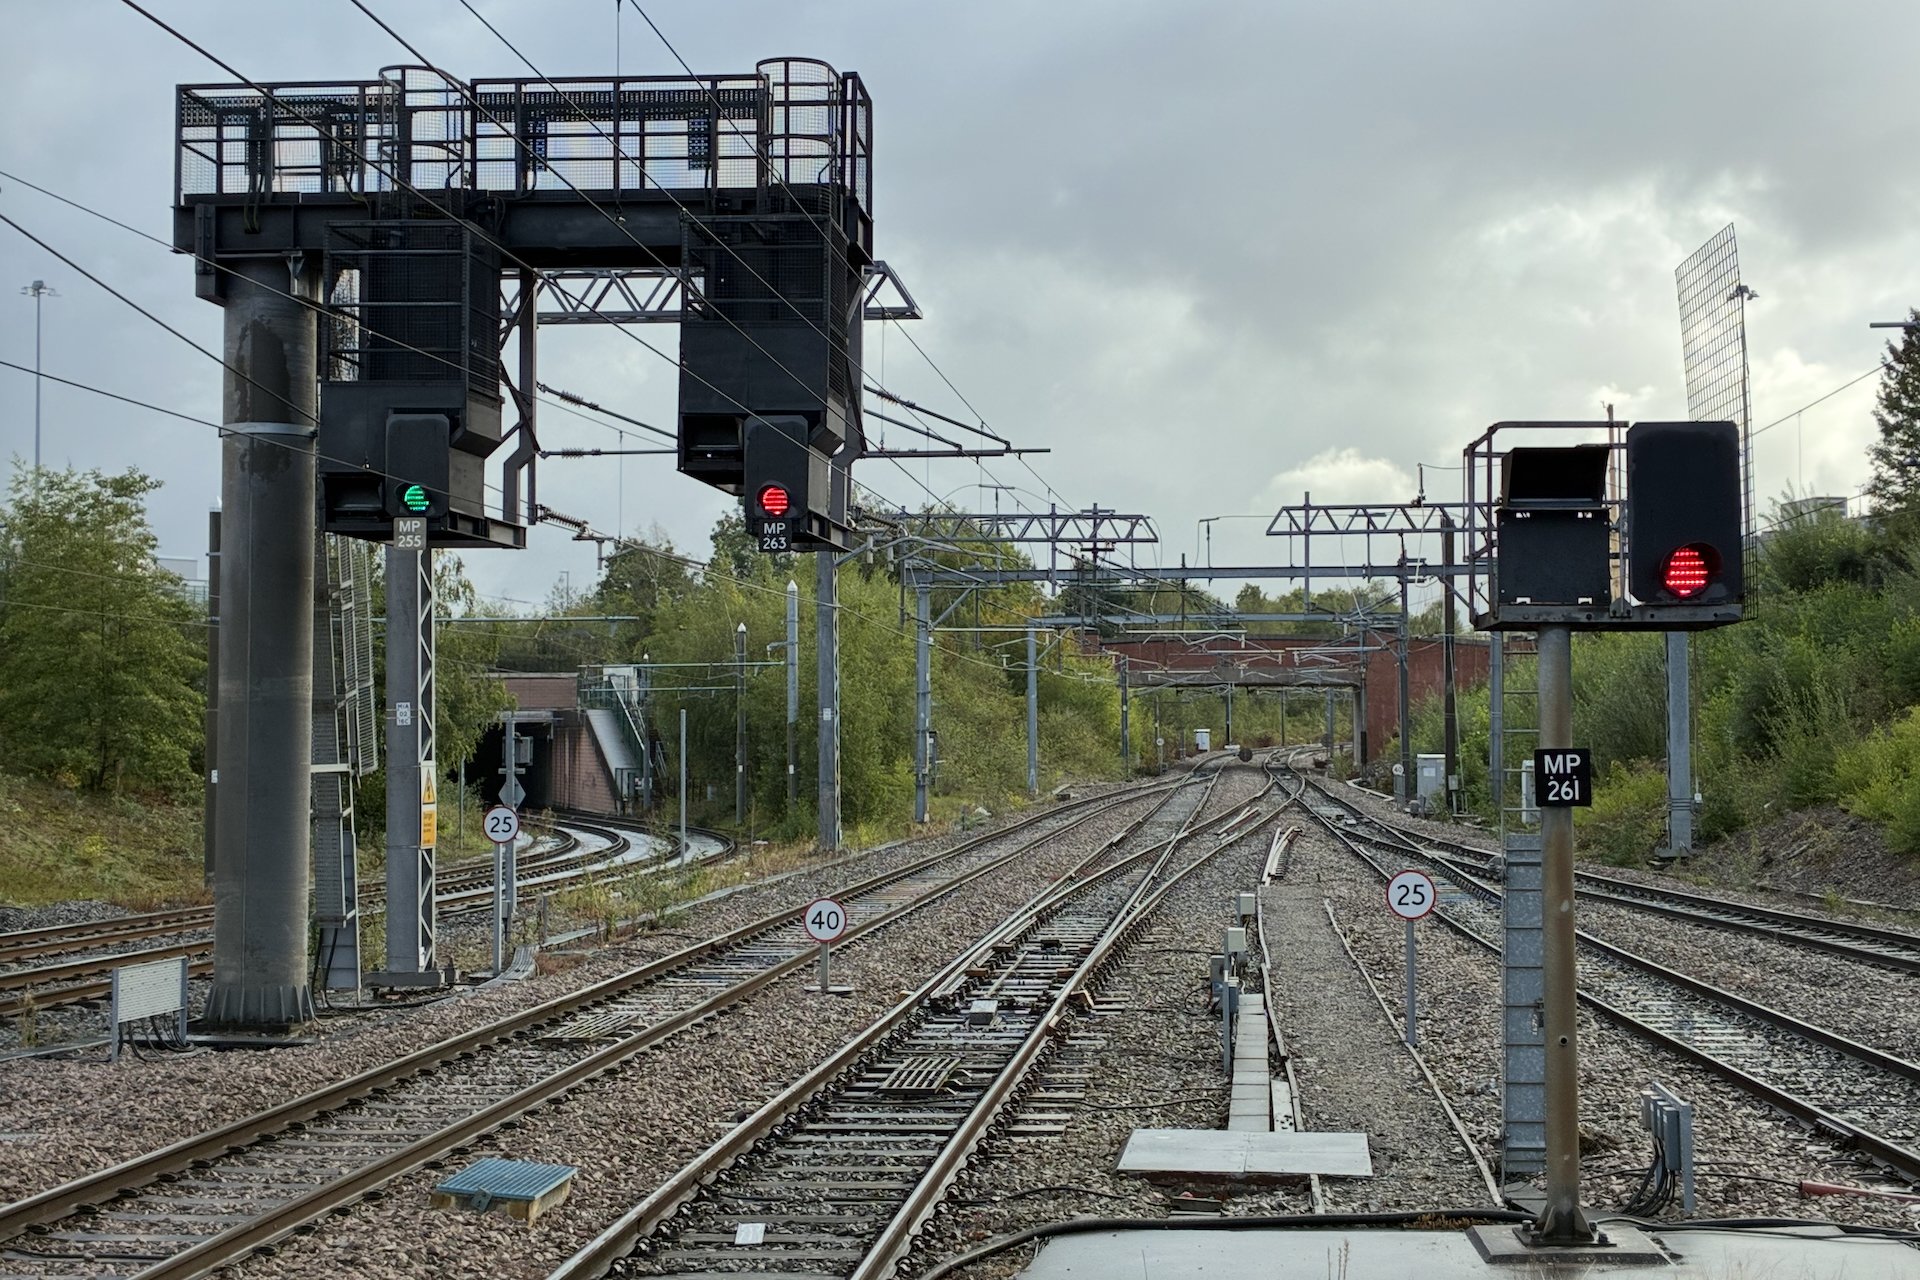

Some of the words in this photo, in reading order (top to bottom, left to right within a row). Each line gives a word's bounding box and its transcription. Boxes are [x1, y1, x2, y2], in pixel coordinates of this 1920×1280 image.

[399, 520, 421, 533] MP
[763, 522, 786, 535] MP
[398, 534, 422, 548] 255
[762, 536, 787, 550] 263
[1544, 754, 1581, 774] MP
[1547, 779, 1580, 800] 261
[490, 816, 512, 833] 25
[1397, 884, 1425, 906] 25
[811, 910, 839, 930] 40
